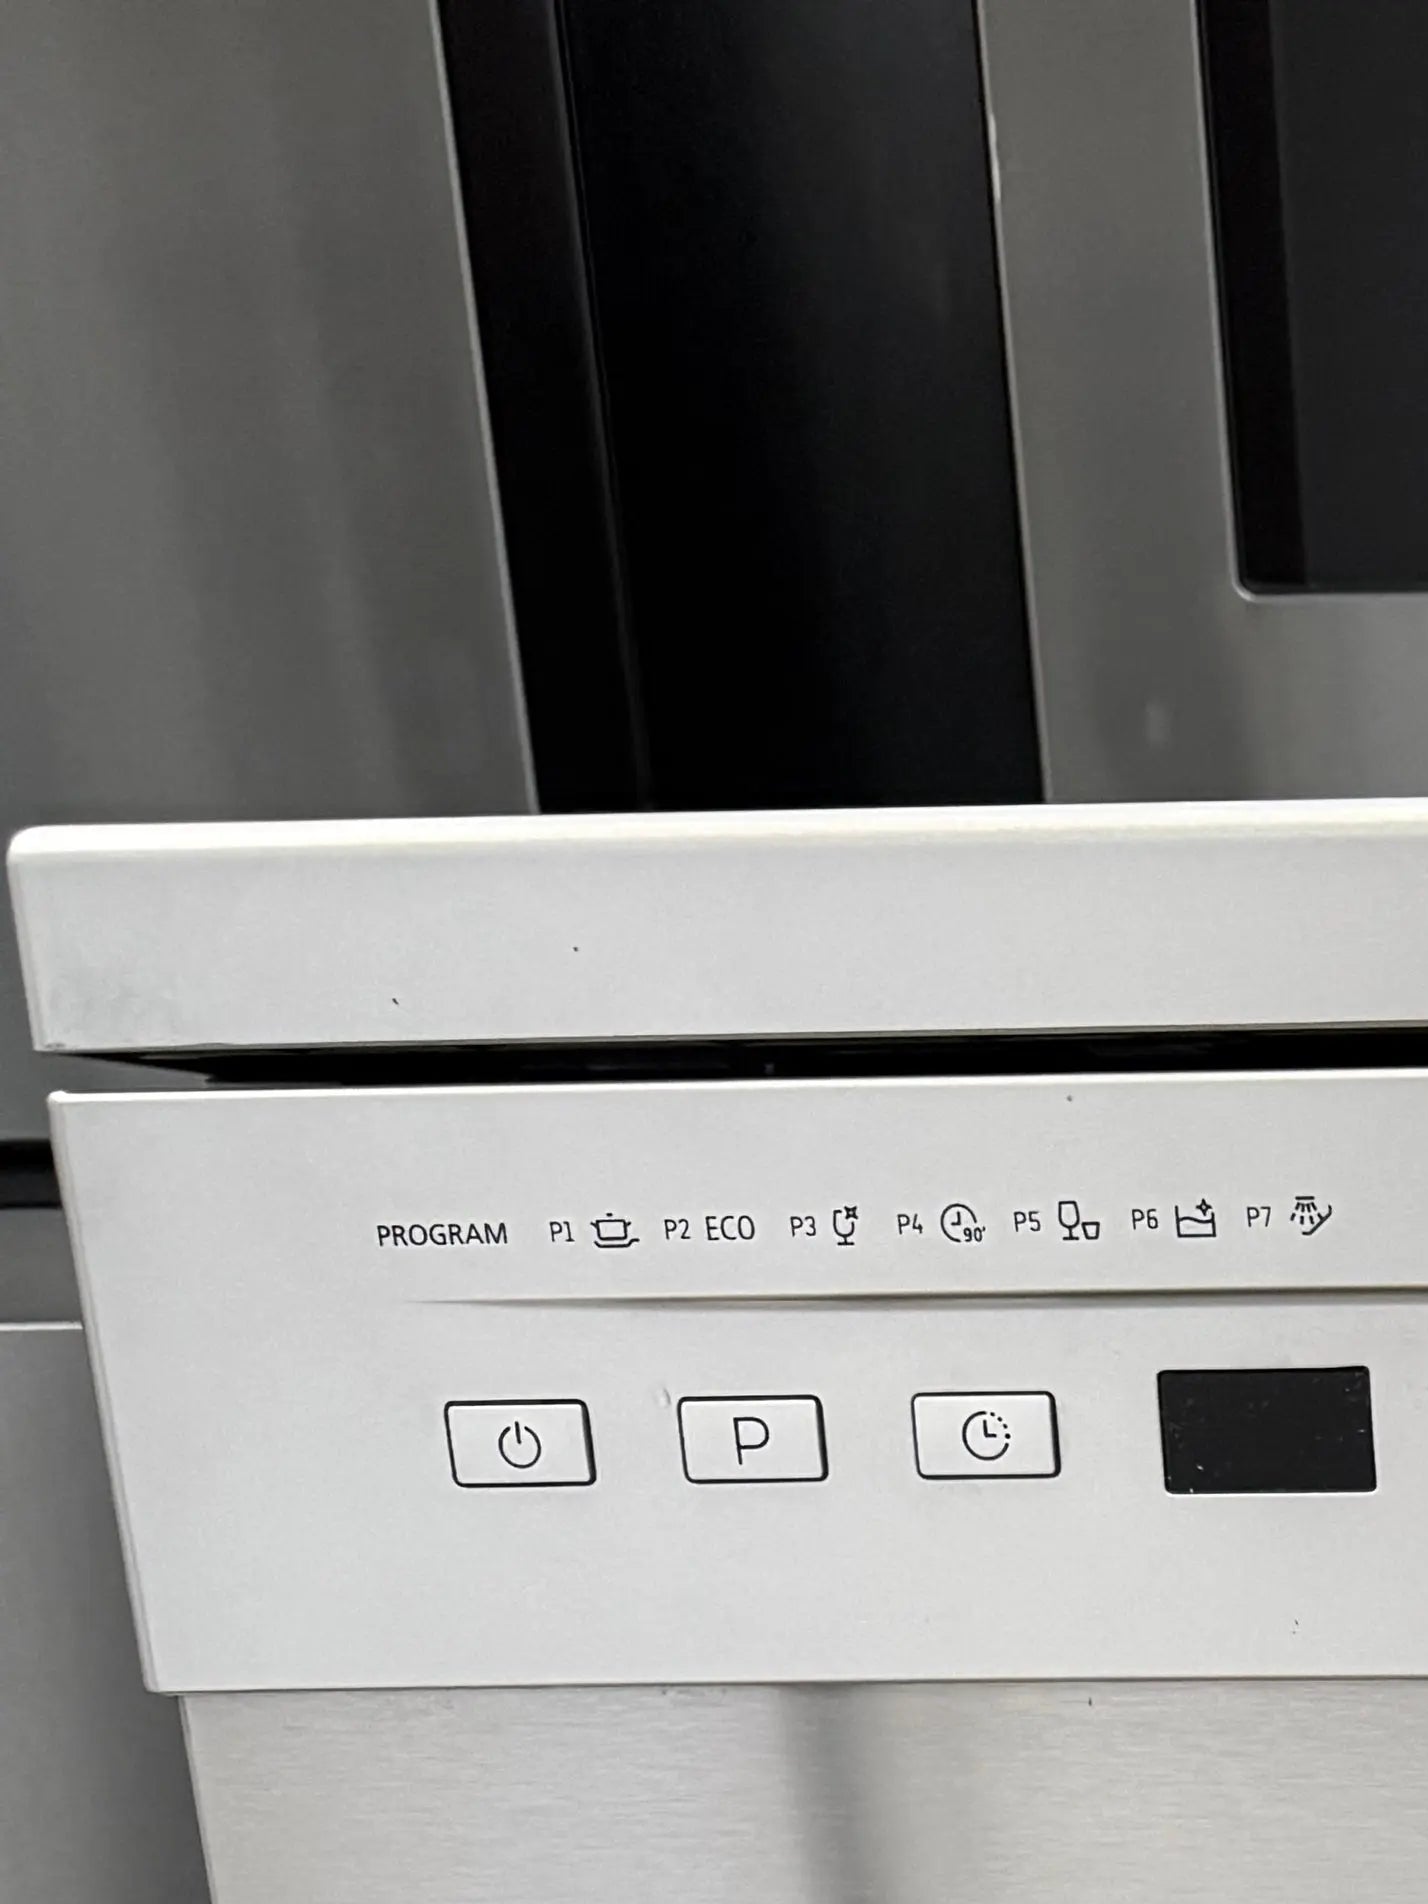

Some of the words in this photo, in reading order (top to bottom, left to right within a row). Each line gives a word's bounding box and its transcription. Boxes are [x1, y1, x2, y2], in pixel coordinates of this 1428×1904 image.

[377, 1222, 508, 1246] PROGRAM
[550, 1221, 575, 1243] P1
[664, 1218, 691, 1240] P2
[705, 1216, 756, 1240] ECO
[790, 1216, 816, 1238] P3
[897, 1213, 923, 1235] P4
[1014, 1211, 1041, 1233] P5
[1131, 1208, 1158, 1230] P6
[1247, 1206, 1271, 1228] P7
[732, 1417, 769, 1465] P
